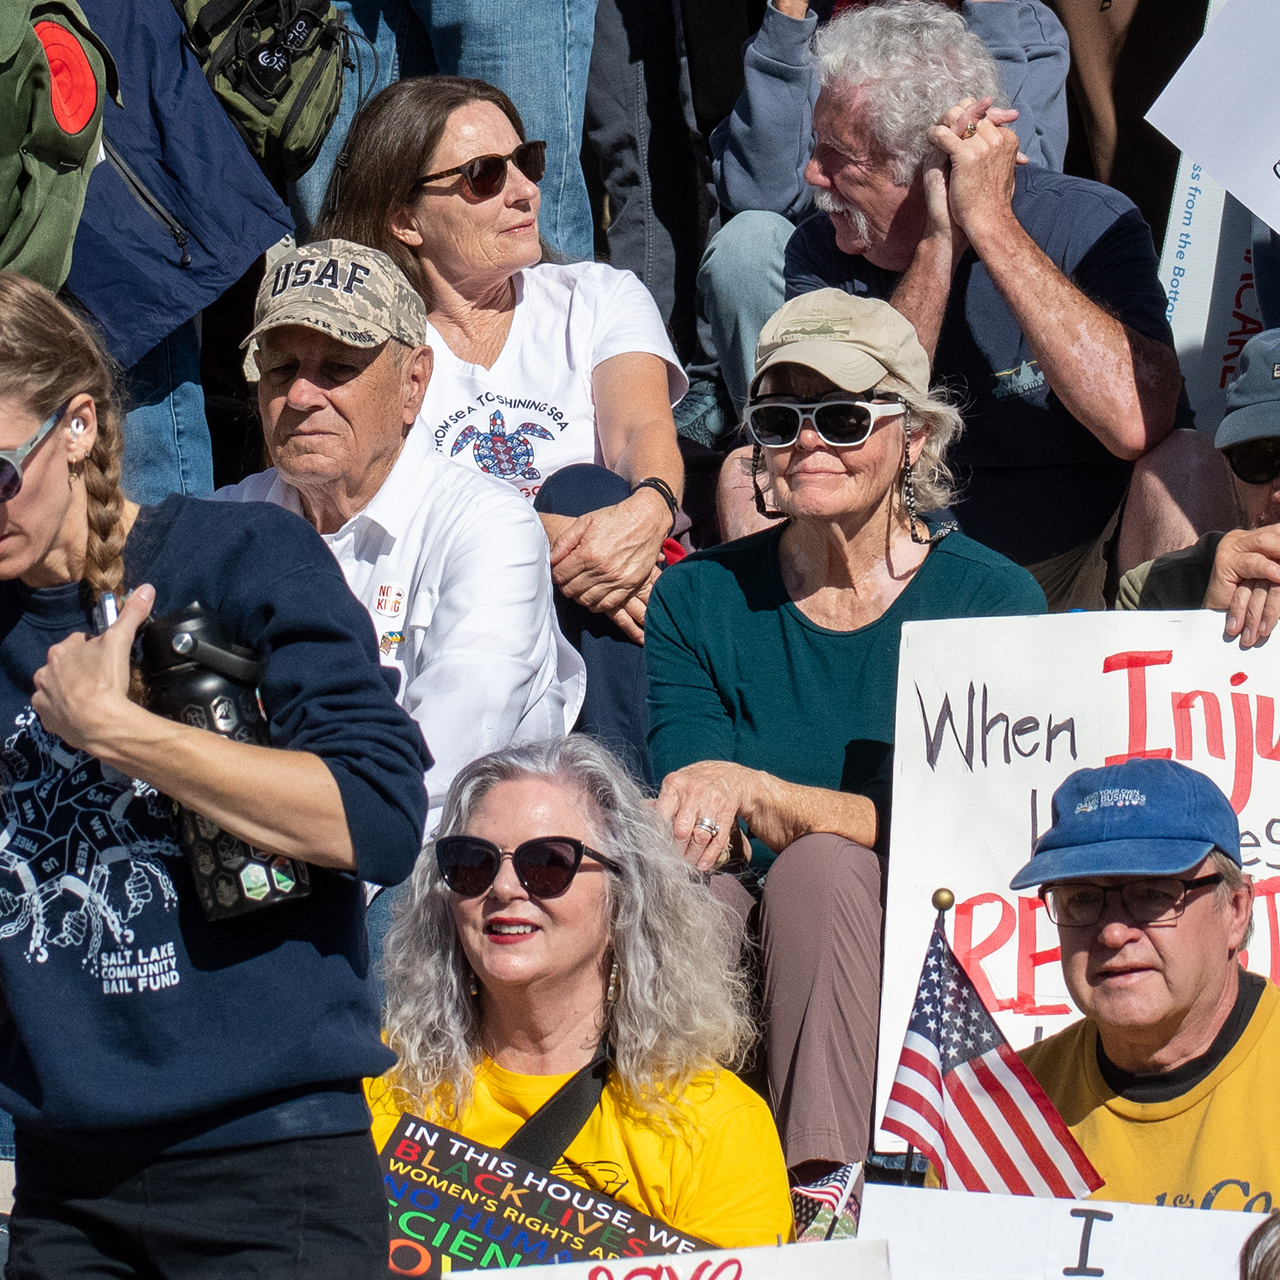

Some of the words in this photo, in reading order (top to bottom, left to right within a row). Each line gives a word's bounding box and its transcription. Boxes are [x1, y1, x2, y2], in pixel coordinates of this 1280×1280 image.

[1181, 186, 1201, 227] from
[1175, 232, 1192, 260] the
[271, 258, 371, 297] USAF
[1165, 266, 1186, 324] Botto
[302, 314, 332, 331] AIR
[338, 327, 376, 343] FORCE
[476, 391, 496, 407] TO
[496, 395, 548, 413] SHINING
[379, 585, 393, 597] NO
[914, 681, 1077, 773] When
[1099, 788, 1120, 796] YOUR
[1120, 788, 1140, 796] OWN
[1100, 793, 1147, 802] BUSINESS
[101, 950, 133, 967] SALT
[138, 942, 176, 963] LAKE
[101, 957, 177, 980] COMMUNITY
[103, 979, 134, 995] BAIL
[138, 970, 180, 992] FUND
[389, 1158, 497, 1212] WOMEN'S
[503, 1205, 585, 1251] RIGHTS
[394, 1138, 530, 1208] BLACK
[537, 1198, 648, 1259] LIVES
[405, 1121, 439, 1148] IN
[448, 1137, 517, 1178] THIS
[523, 1171, 636, 1234] HOUSE,
[648, 1224, 696, 1256] WE
[383, 1173, 440, 1211] NO
[451, 1202, 573, 1264] HUMA
[386, 1198, 542, 1270] CIEN
